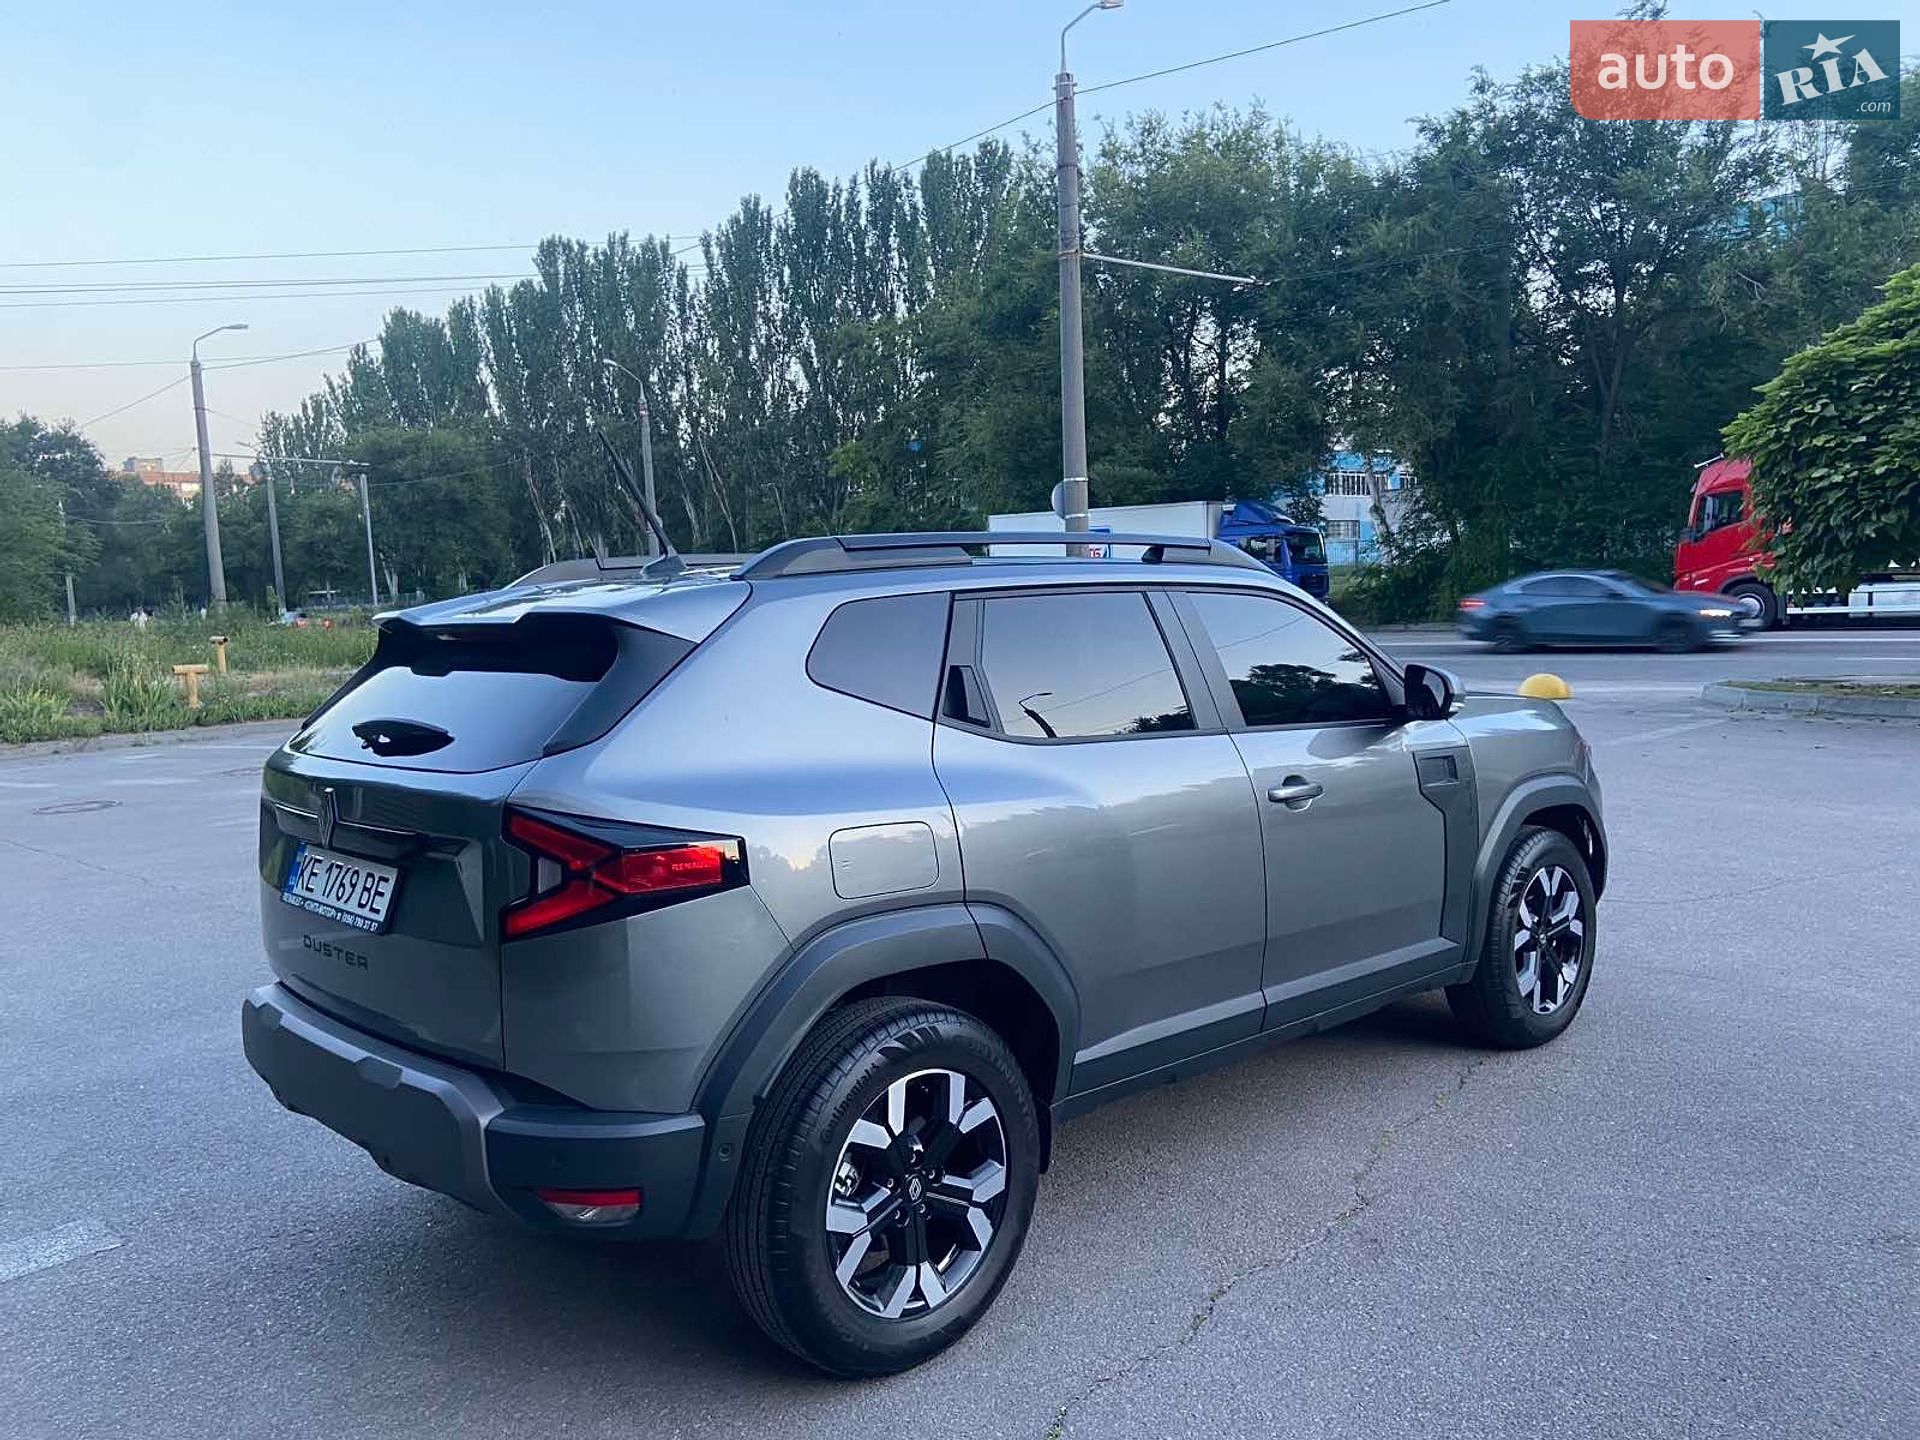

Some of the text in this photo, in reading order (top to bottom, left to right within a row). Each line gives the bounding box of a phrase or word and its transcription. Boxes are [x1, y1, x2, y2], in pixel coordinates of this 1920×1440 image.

[295, 854, 323, 893] KE
[322, 861, 360, 904] 1769
[357, 871, 390, 915] BE
[303, 934, 368, 971] DUSTER
